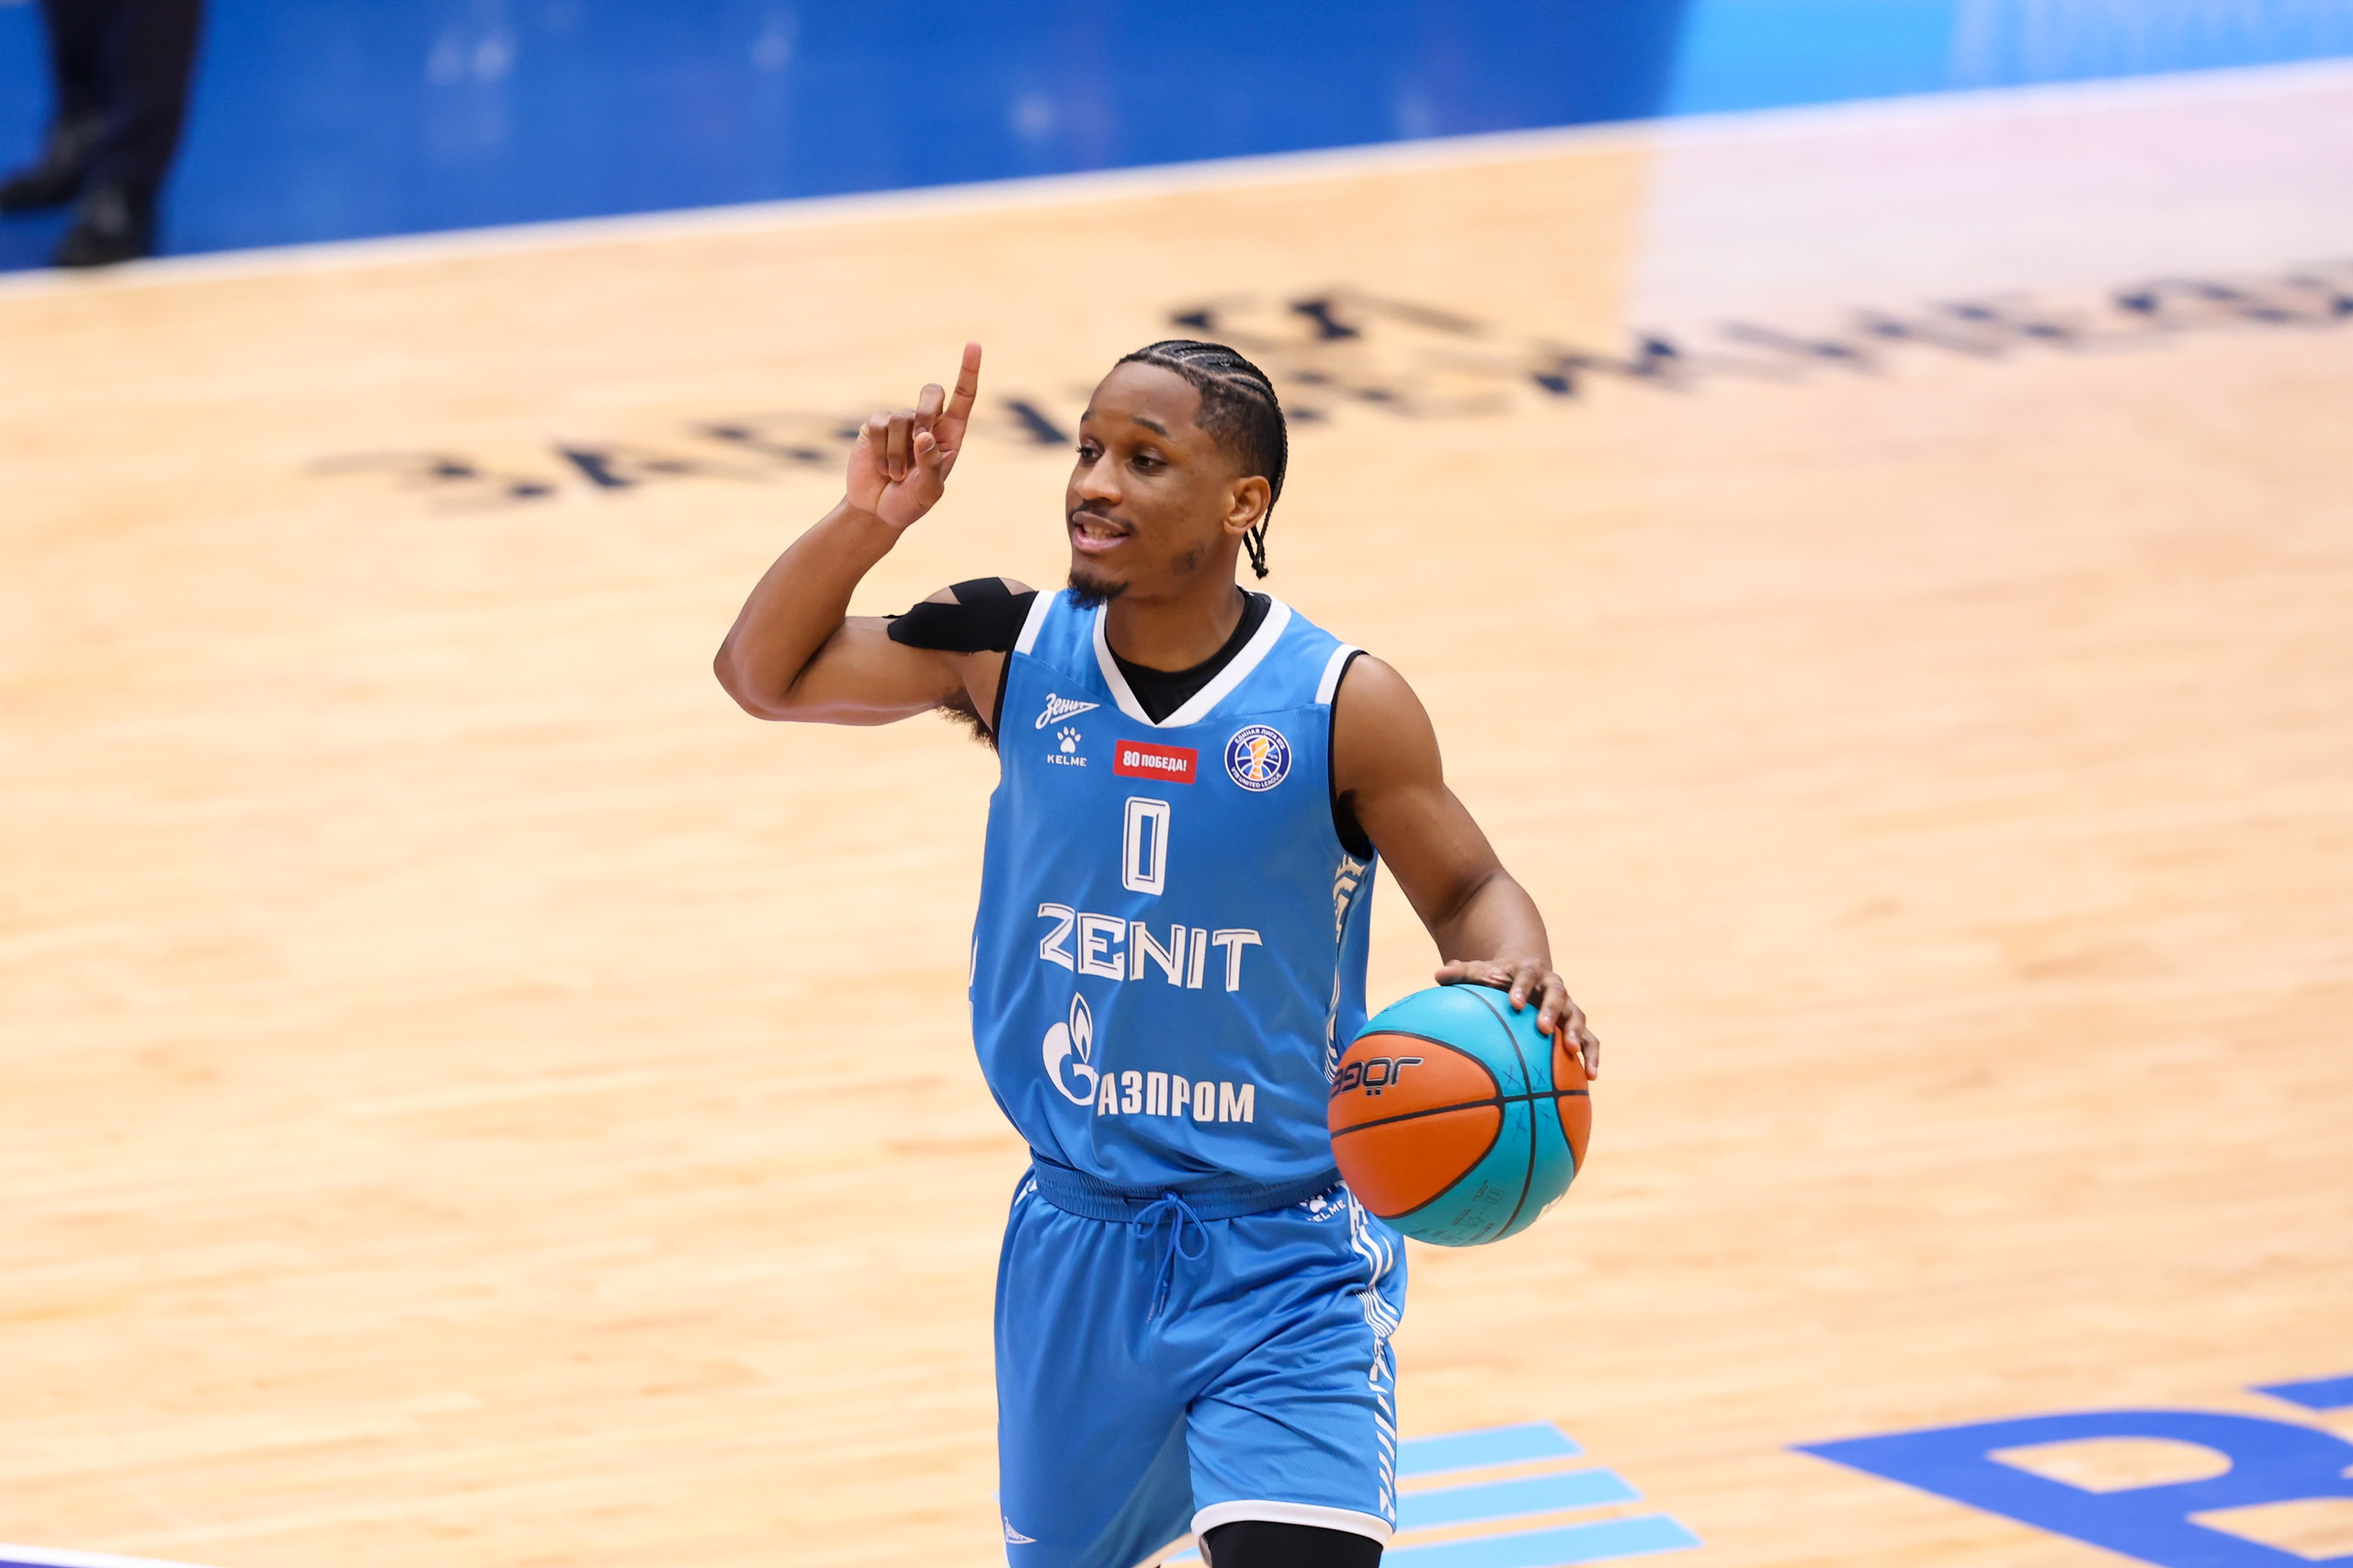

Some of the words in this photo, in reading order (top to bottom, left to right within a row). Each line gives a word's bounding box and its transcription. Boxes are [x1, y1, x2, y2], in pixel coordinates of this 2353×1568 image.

[1233, 728, 1260, 744] ЕДИНАЯ
[1047, 754, 1087, 767] KELME
[1122, 750, 1141, 767] 80
[1141, 754, 1188, 772] ПОБЕДА!
[1238, 777, 1261, 789] UNITED
[1261, 771, 1282, 788] LEAGUE
[1121, 796, 1171, 896] 0
[1037, 903, 1263, 993] ZENIT
